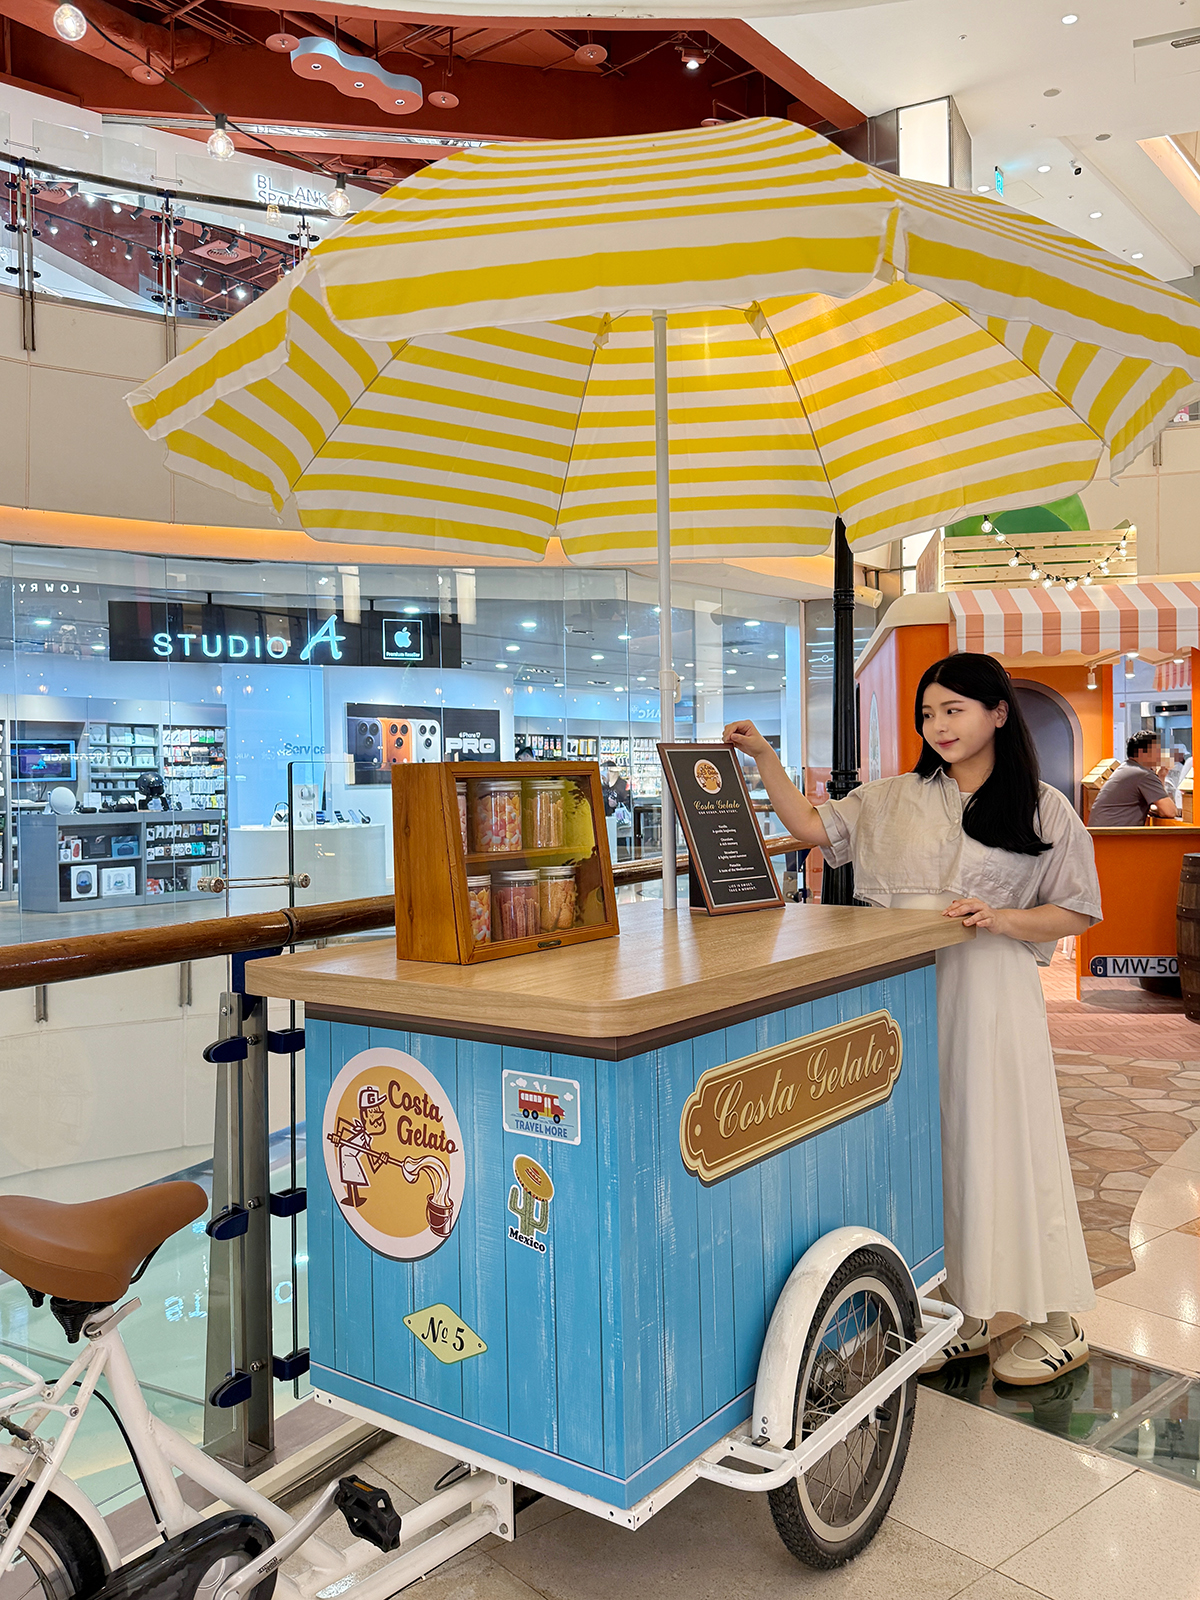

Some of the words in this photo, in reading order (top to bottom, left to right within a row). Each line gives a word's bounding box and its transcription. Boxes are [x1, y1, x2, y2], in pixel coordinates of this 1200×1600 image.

[257, 174, 329, 208] BLANK
[153, 633, 288, 659] STUDIO
[300, 614, 346, 661] A
[284, 742, 325, 754] Servce
[445, 738, 496, 754] PRO
[1096, 966, 1104, 974] D
[1112, 958, 1179, 974] MW-50
[714, 1069, 802, 1138] Costa
[807, 1034, 889, 1100] Gelato
[388, 1080, 443, 1122] Costa
[397, 1115, 459, 1154] Gelato
[515, 1119, 544, 1134] TRAVEL
[544, 1125, 568, 1138] MORE
[509, 1227, 546, 1252] Mexico
[452, 1326, 465, 1352] 5
